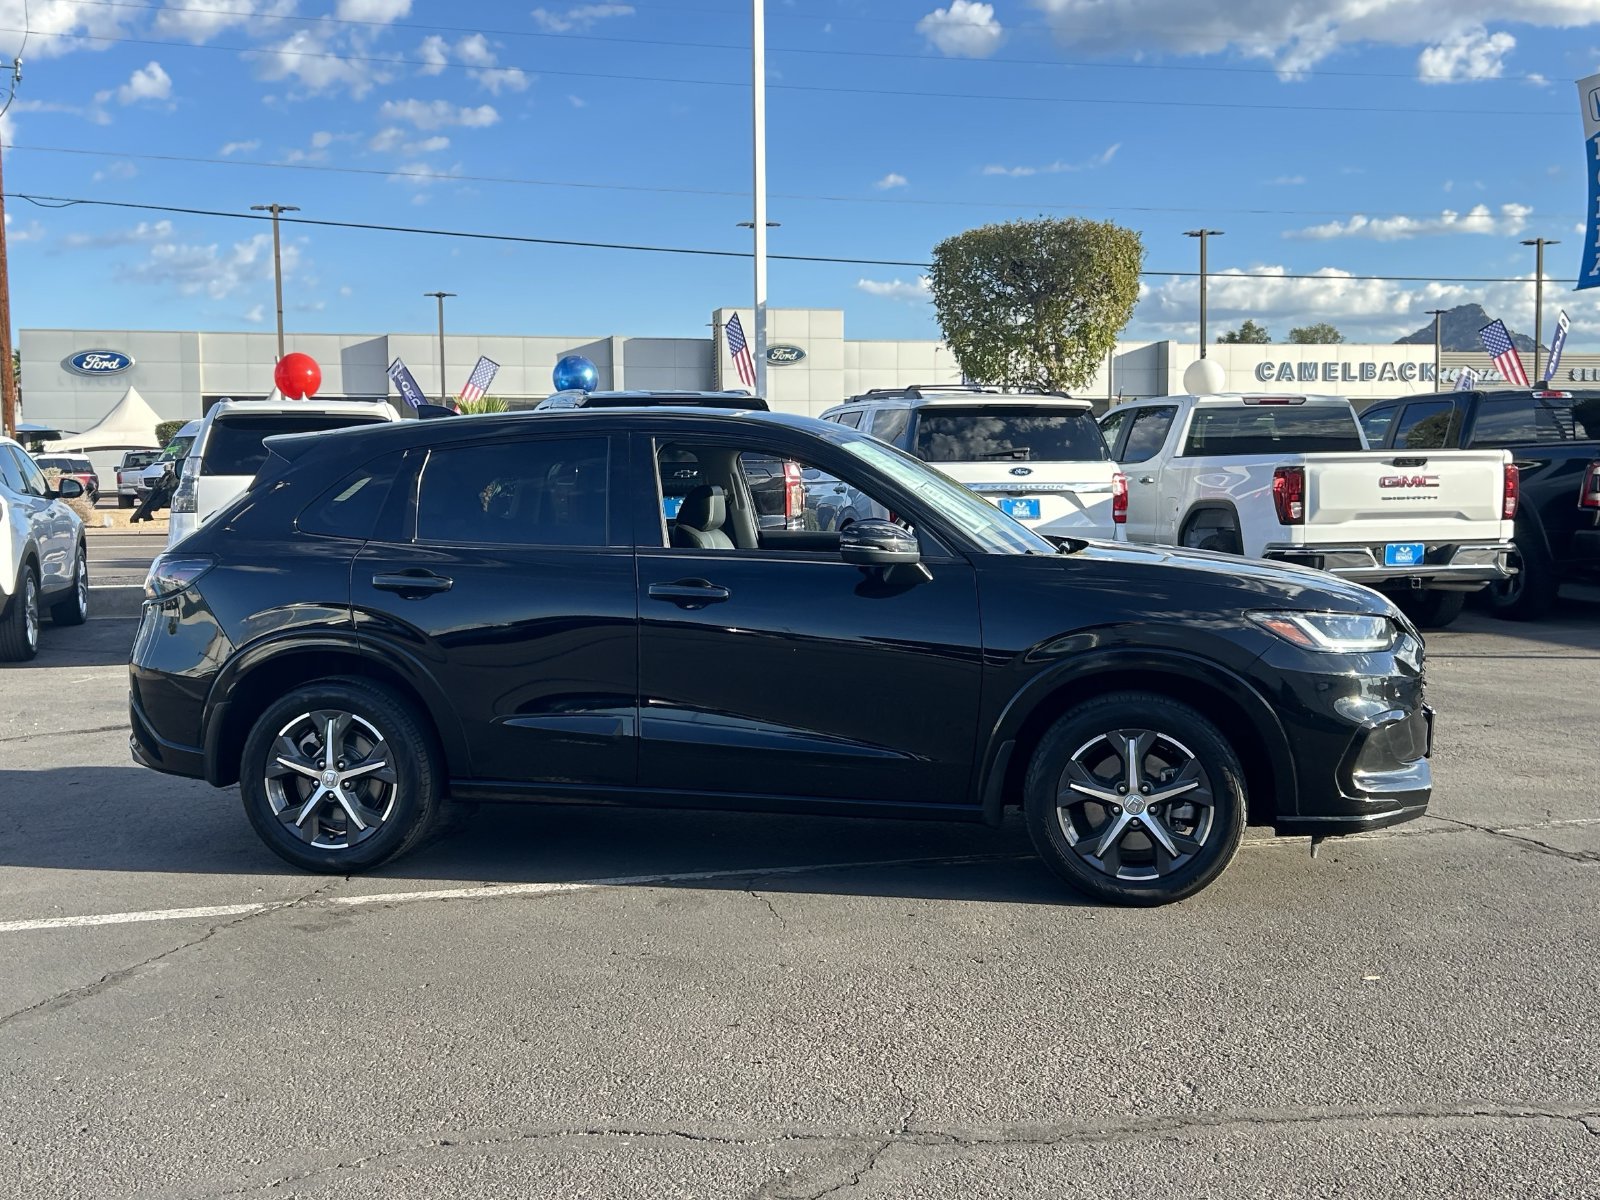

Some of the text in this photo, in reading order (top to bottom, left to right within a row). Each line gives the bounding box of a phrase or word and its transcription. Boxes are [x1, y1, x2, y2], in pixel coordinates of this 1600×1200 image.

[82, 354, 120, 369] Ford
[771, 348, 798, 360] Ford
[1256, 361, 1436, 381] CAMELBACK
[397, 372, 421, 408] FORD
[1379, 475, 1440, 488] GMC
